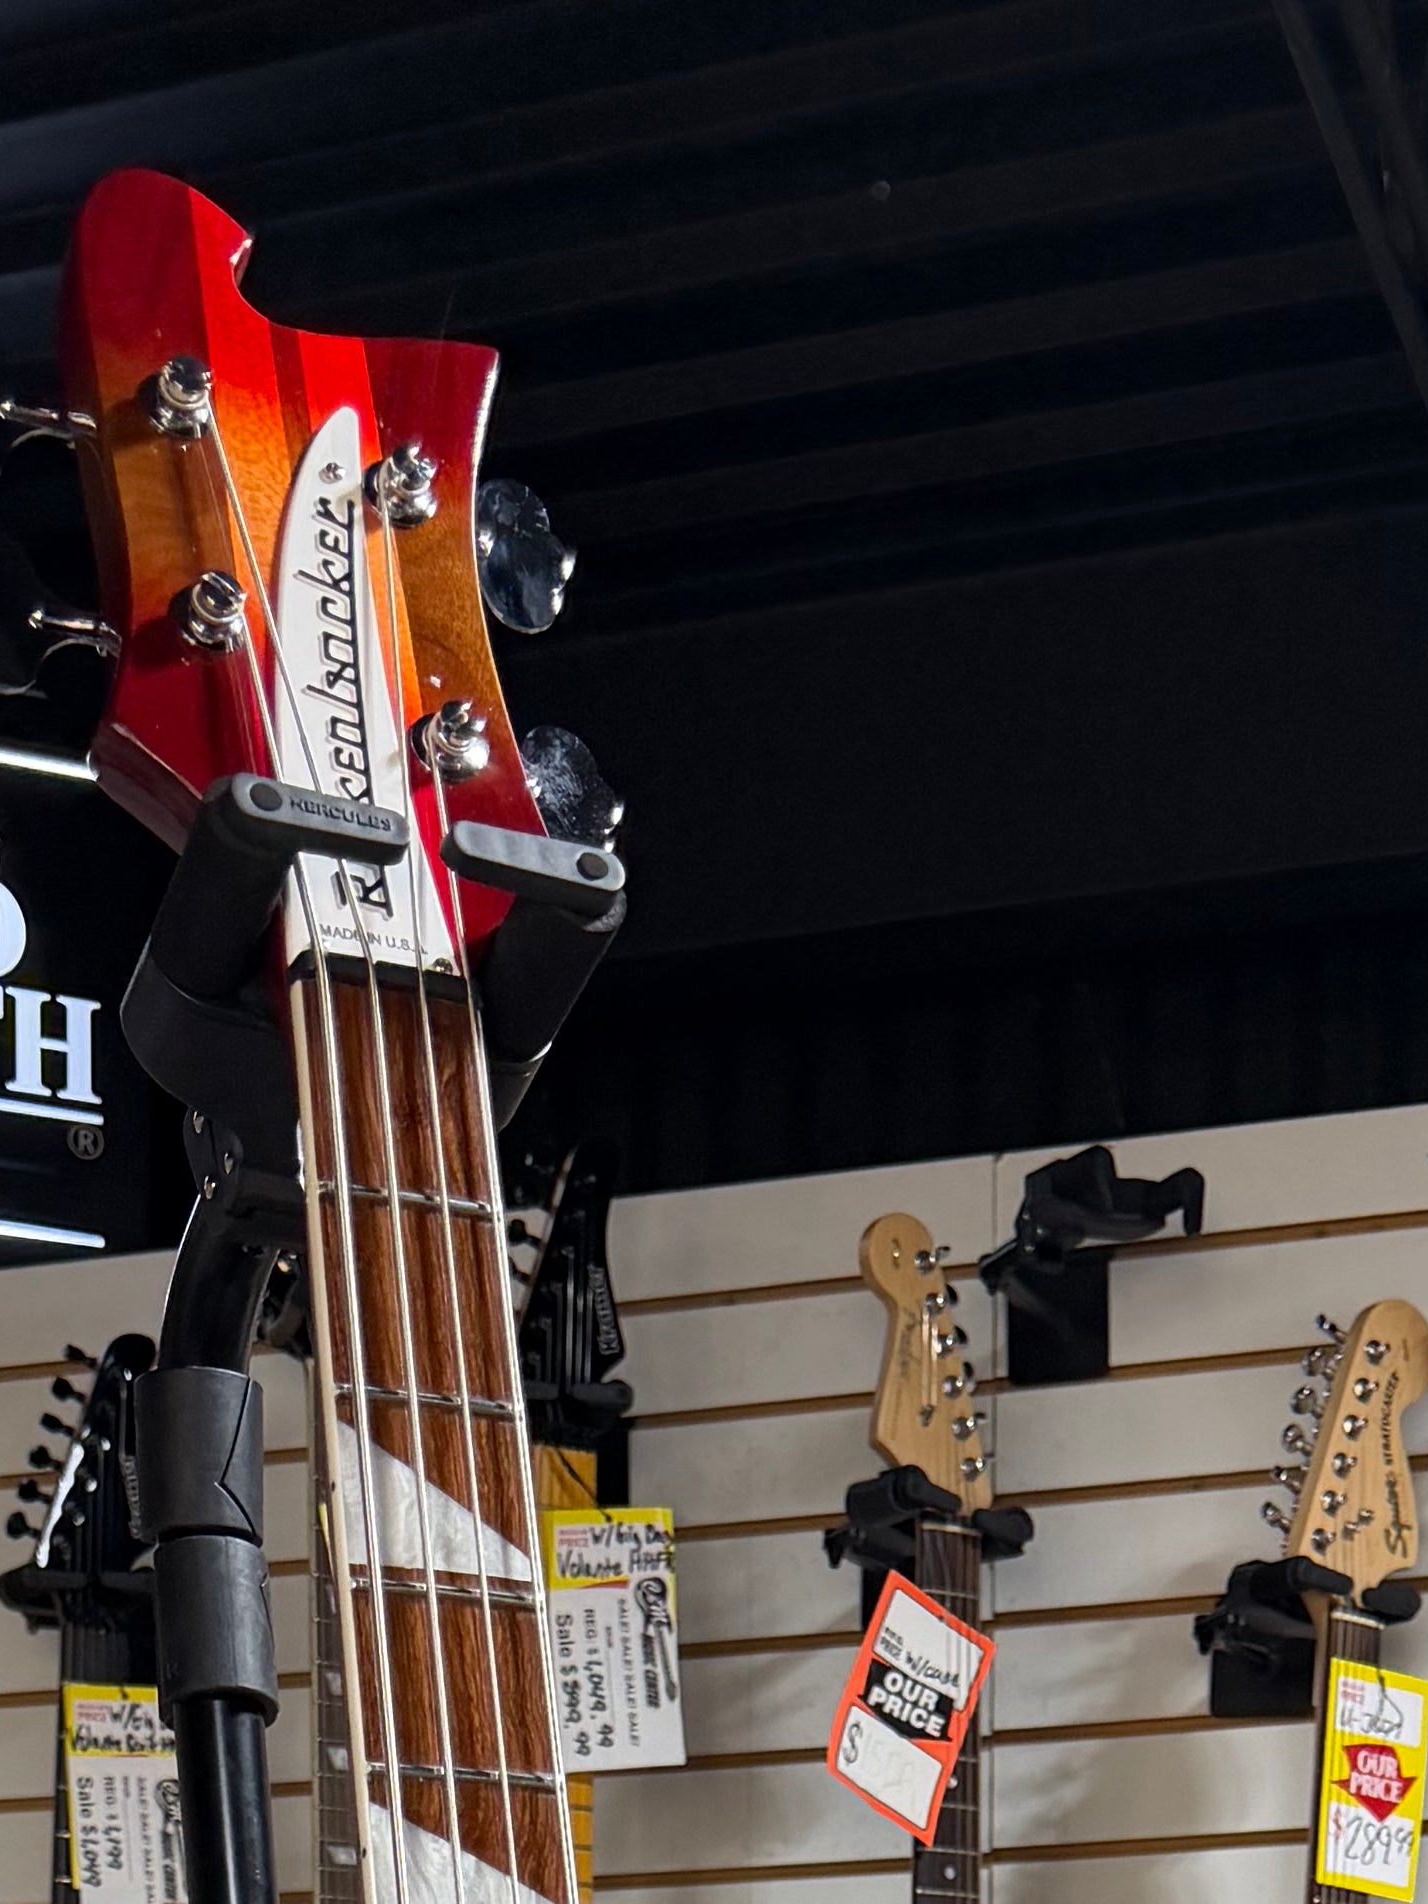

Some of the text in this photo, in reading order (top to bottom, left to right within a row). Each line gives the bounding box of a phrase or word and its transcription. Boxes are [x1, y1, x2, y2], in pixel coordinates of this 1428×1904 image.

[289, 796, 392, 832] HERCULES
[555, 1613, 574, 1658] Sale
[645, 1668, 660, 1709] CENTER
[883, 1670, 940, 1711] OUR
[867, 1687, 946, 1738] PRICE
[1356, 1750, 1398, 1778] OUR
[76, 1775, 95, 1818] Sale
[1349, 1771, 1404, 1803] PRICE
